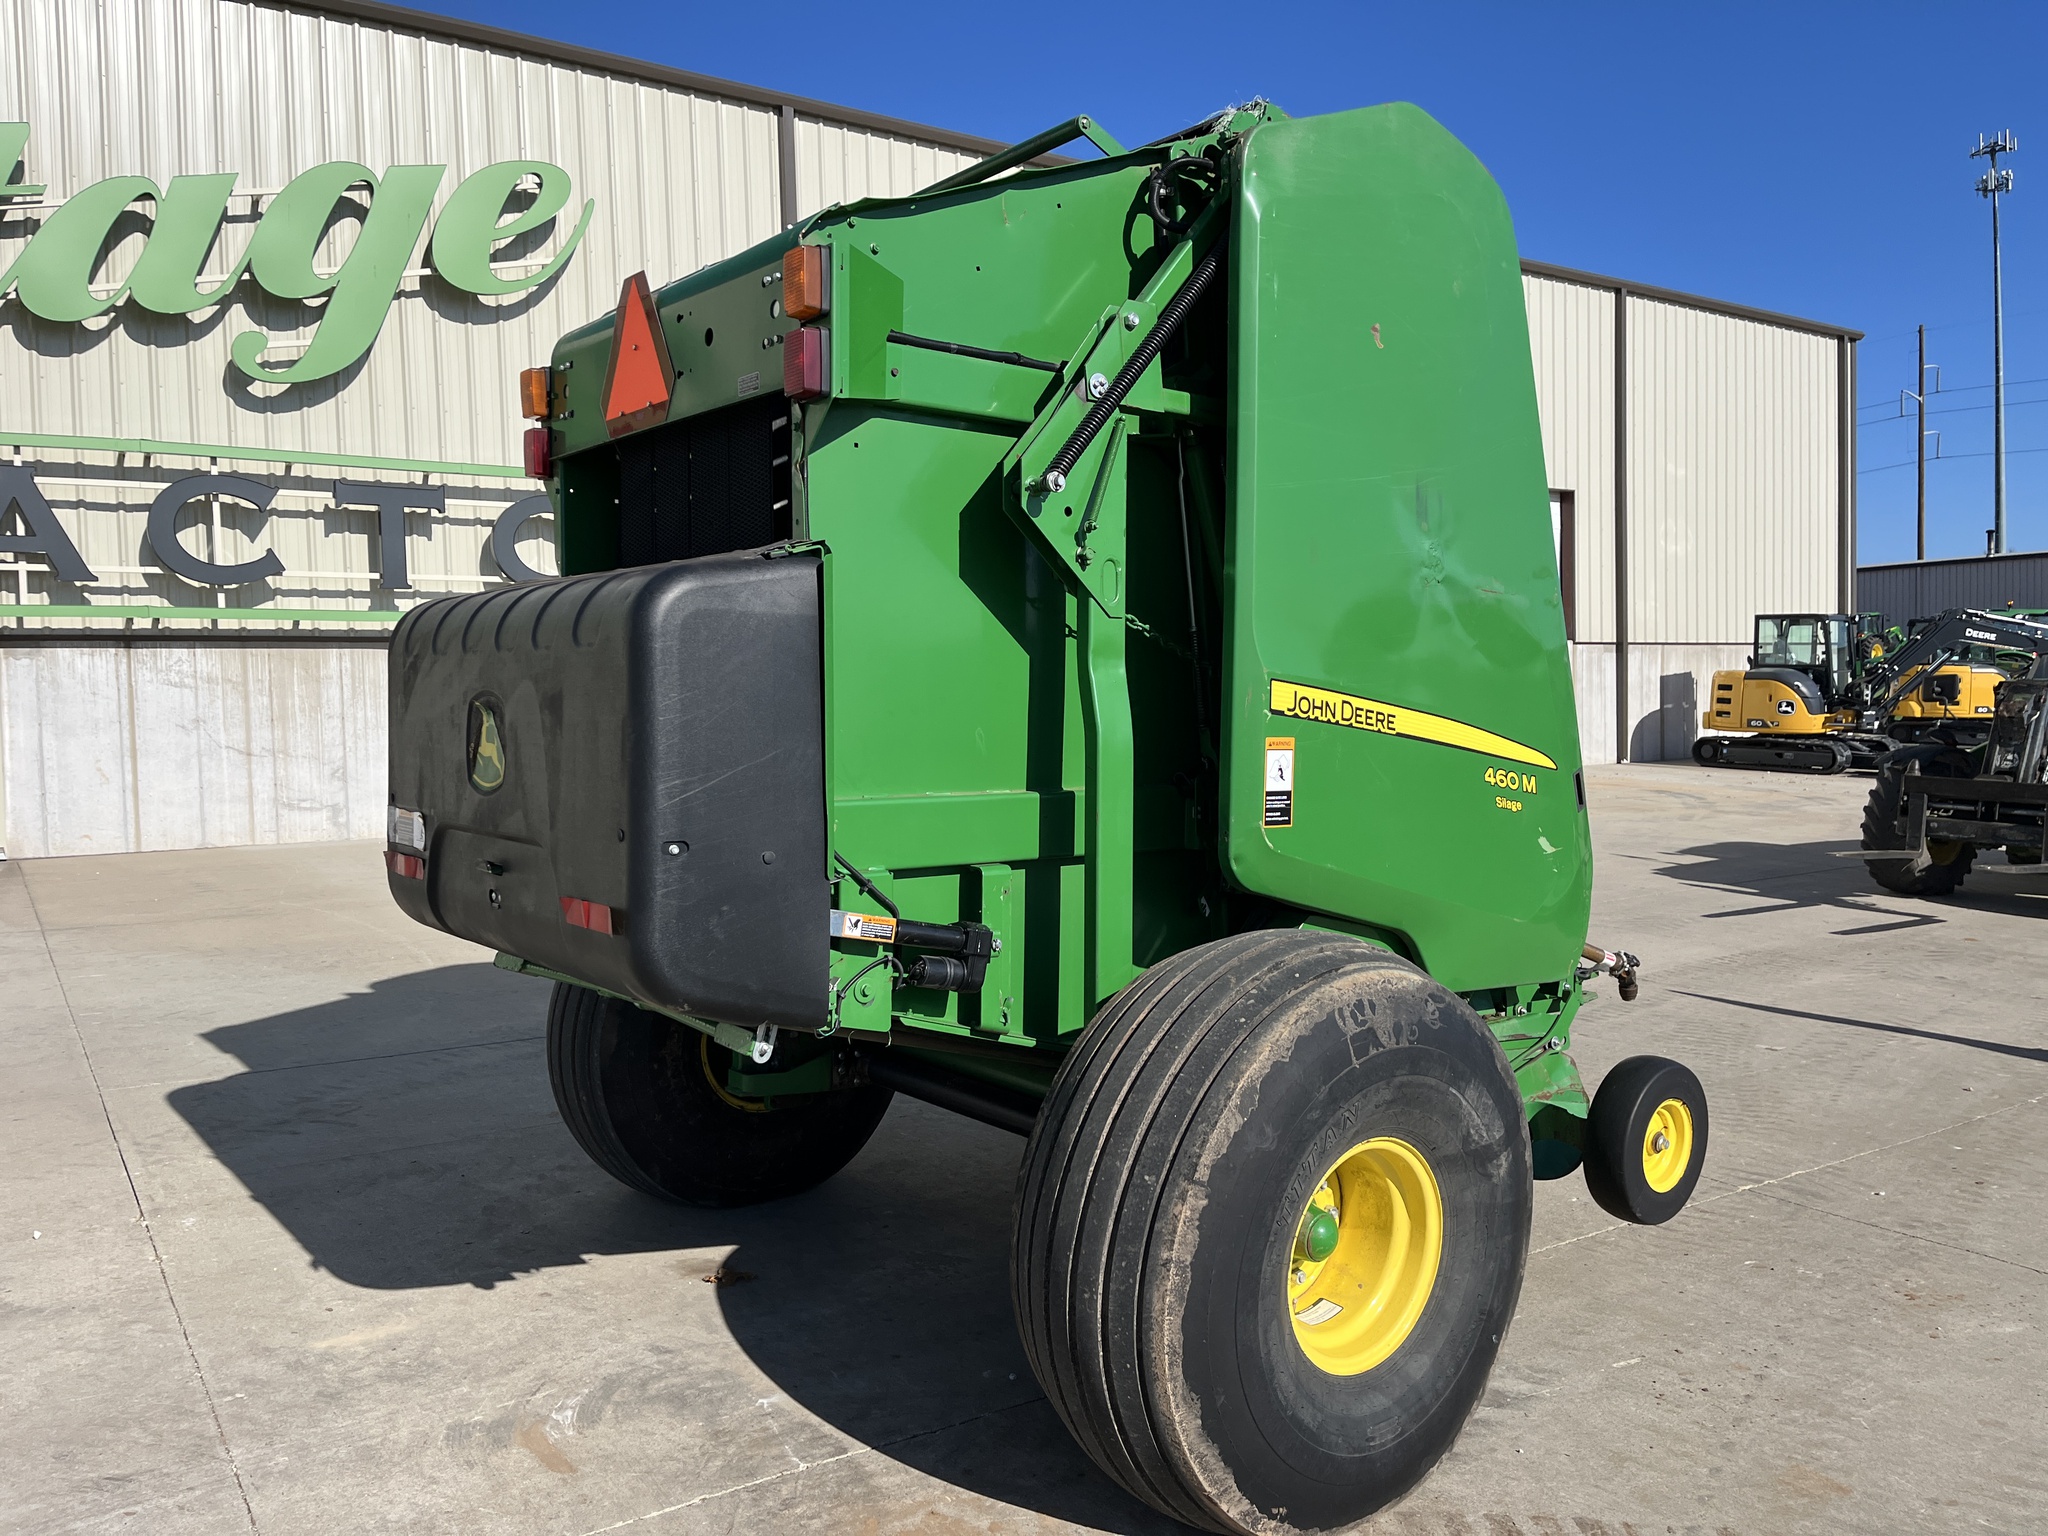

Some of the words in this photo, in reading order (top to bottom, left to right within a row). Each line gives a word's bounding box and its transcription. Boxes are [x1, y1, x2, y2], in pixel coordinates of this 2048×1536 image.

[1965, 628, 1997, 641] DEERE
[1287, 690, 1337, 719] JOHN
[1341, 699, 1396, 731] DEERE
[1484, 767, 1519, 790] 460
[1522, 773, 1537, 794] M
[1495, 796, 1522, 812] Silage
